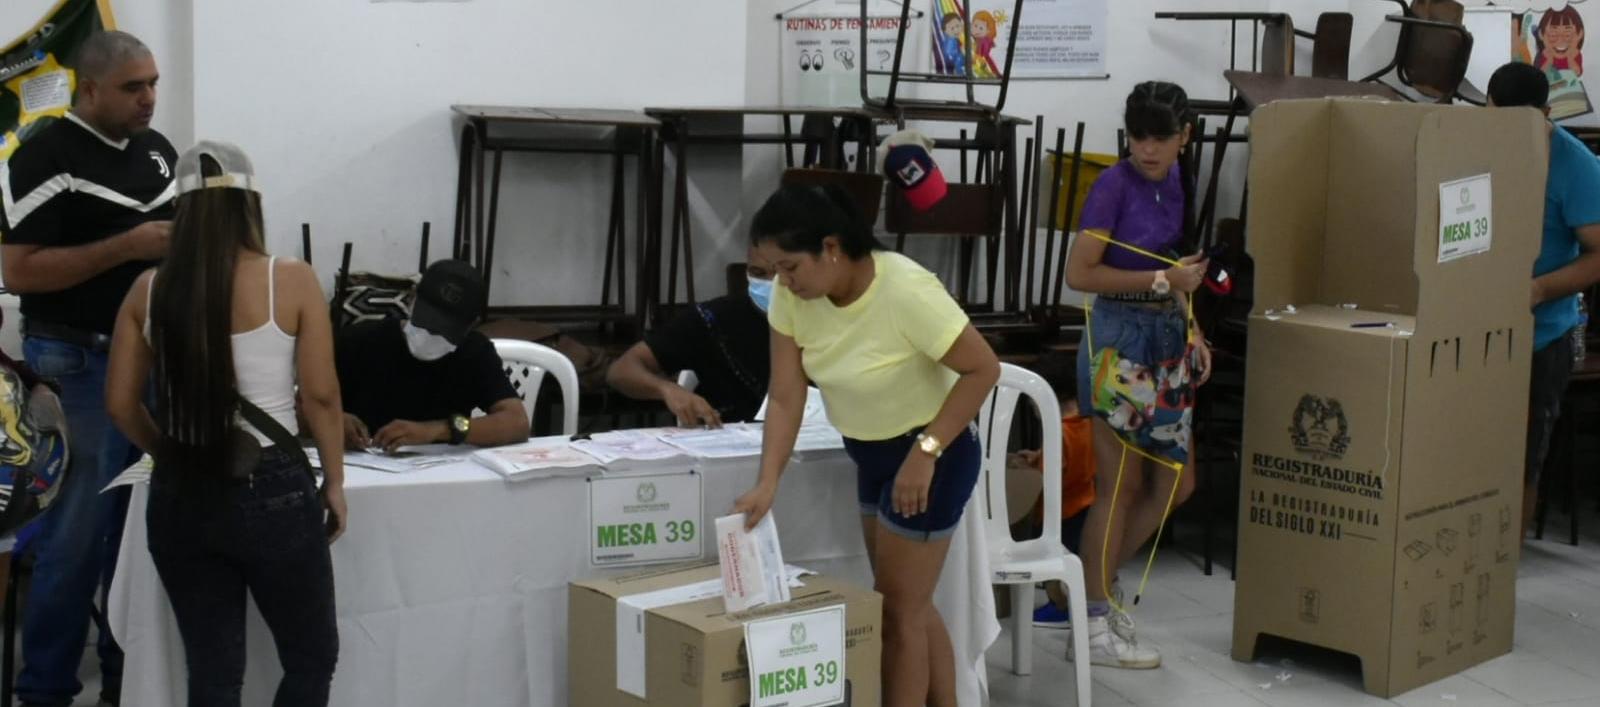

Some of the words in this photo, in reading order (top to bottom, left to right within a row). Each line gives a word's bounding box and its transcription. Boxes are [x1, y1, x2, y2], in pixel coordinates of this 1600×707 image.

[786, 18, 826, 31] RUTINAS
[830, 18, 843, 30] DE
[846, 17, 912, 30] PENAMIENO
[1443, 221, 1471, 244] MESA
[1474, 217, 1488, 237] 39
[1251, 468, 1296, 482] NACIONAL
[1299, 475, 1318, 487] DEL
[1320, 479, 1357, 494] ESTADO
[1358, 487, 1383, 499] CIVIL
[1252, 453, 1384, 489] REGISTRADURÍA
[1250, 490, 1265, 504] LA
[1272, 493, 1380, 526] REGISTRADURÍA
[597, 522, 657, 548] MESA
[665, 519, 695, 543] 39
[1319, 520, 1341, 540] XXI
[758, 666, 808, 698] MESA
[813, 660, 838, 687] 39
